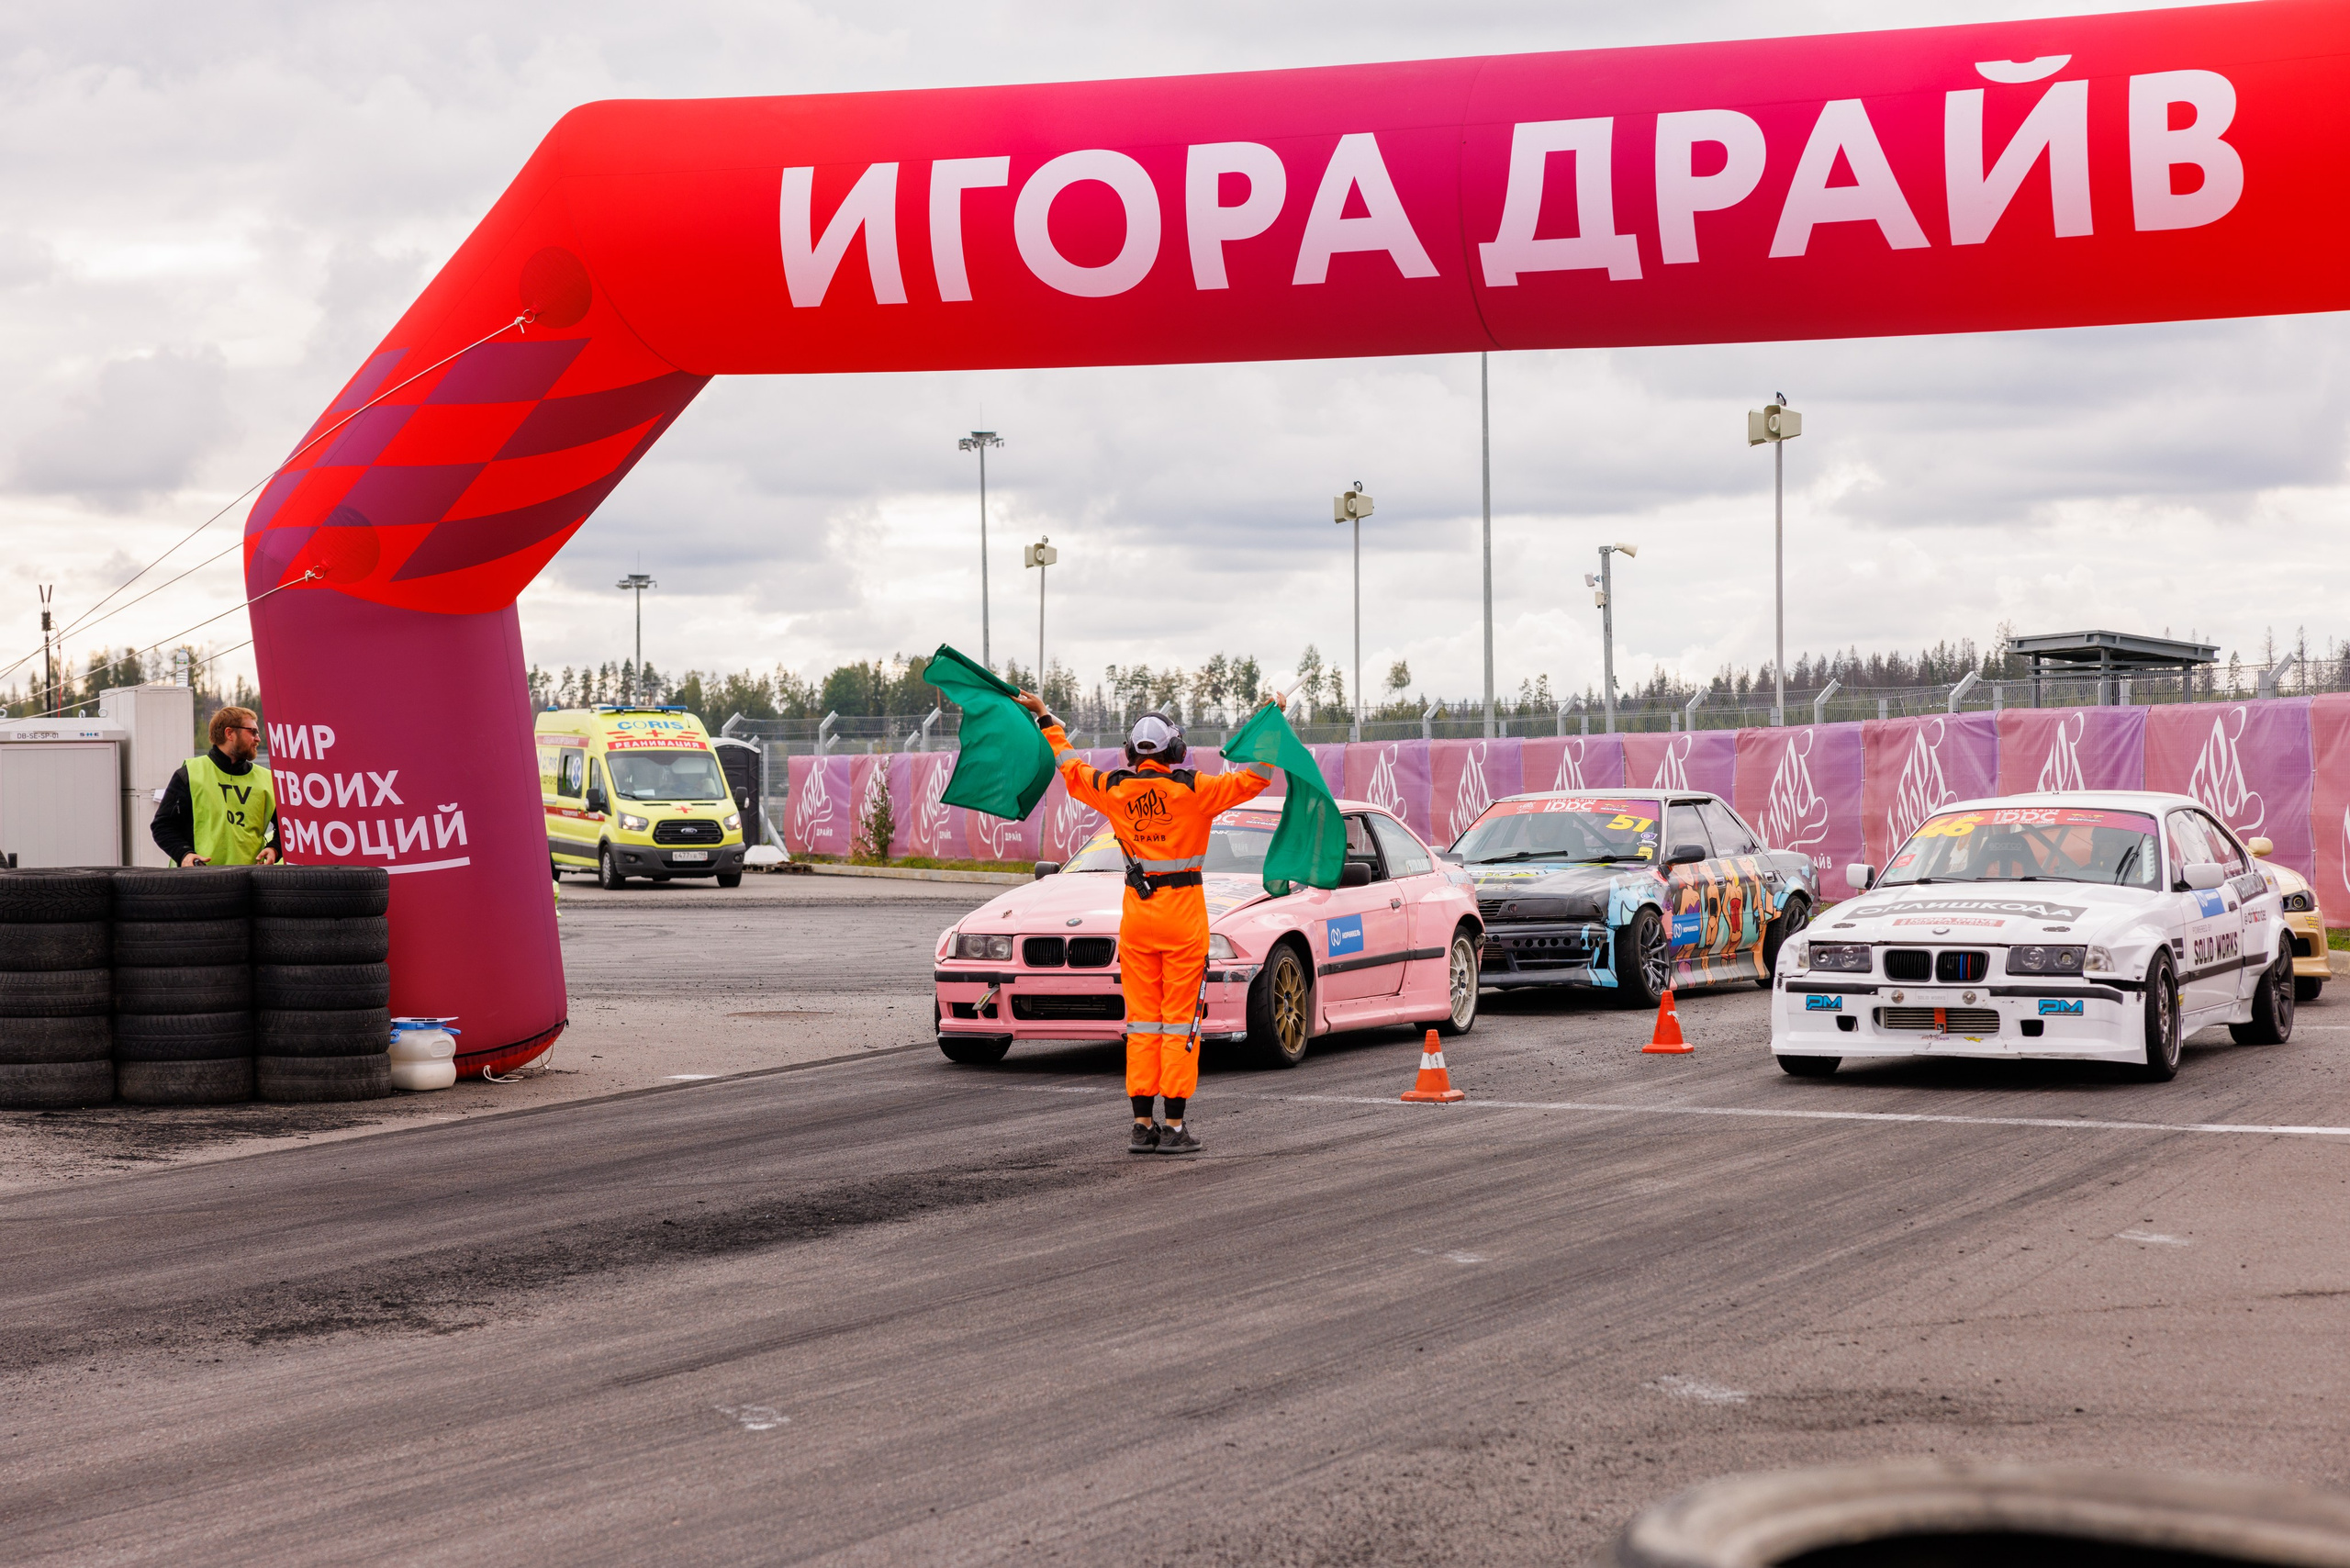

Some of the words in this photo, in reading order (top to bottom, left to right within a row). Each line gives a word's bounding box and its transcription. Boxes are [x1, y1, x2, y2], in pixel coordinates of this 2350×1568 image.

[779, 131, 1440, 308] ИГОРА
[1479, 54, 2245, 286] ДРАЙВ
[617, 721, 685, 730] CORIS
[267, 722, 335, 760] МИР
[615, 739, 699, 749] РЕАНИМАЦИЯ
[218, 782, 252, 804] TV
[274, 769, 404, 809] ТВОИХ
[1544, 801, 1595, 810] IDDC
[227, 810, 245, 827] 02
[1606, 814, 1653, 833] 51
[1993, 812, 2059, 823] IDDC
[281, 802, 468, 860] ЭМОЦИЙ
[1911, 816, 1985, 838] 46
[1134, 834, 1166, 842] ДРАЙВ
[1988, 842, 2022, 850] sparco
[1813, 853, 1831, 869] АЙВ
[2194, 936, 2213, 966] SOLID
[2215, 931, 2238, 961] WORKS
